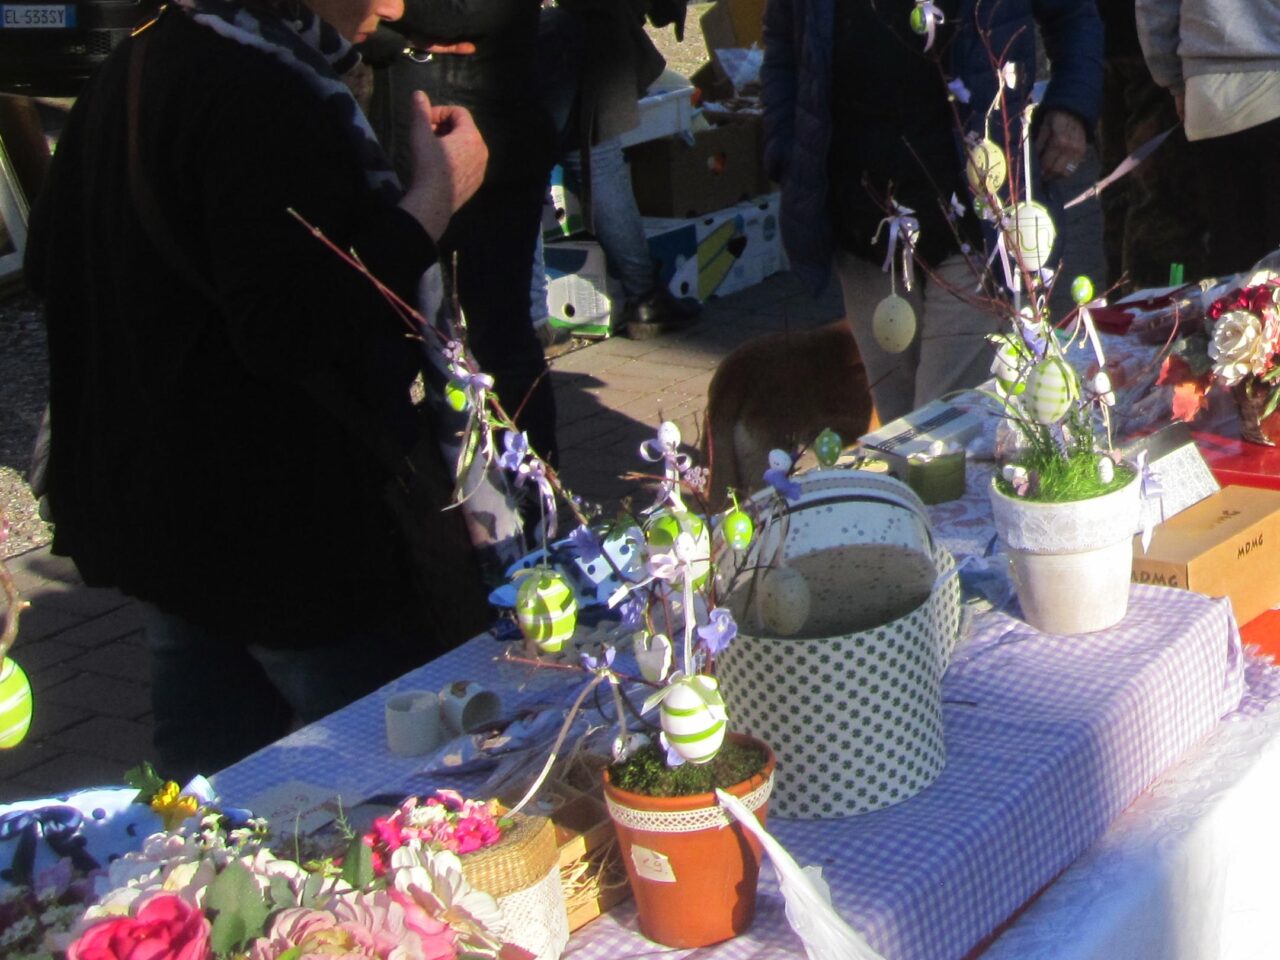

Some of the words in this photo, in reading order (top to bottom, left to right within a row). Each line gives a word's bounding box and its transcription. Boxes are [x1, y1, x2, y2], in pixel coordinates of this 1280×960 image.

[4, 9, 20, 24] EL
[24, 9, 65, 25] 533SY
[1237, 533, 1264, 559] MDMG
